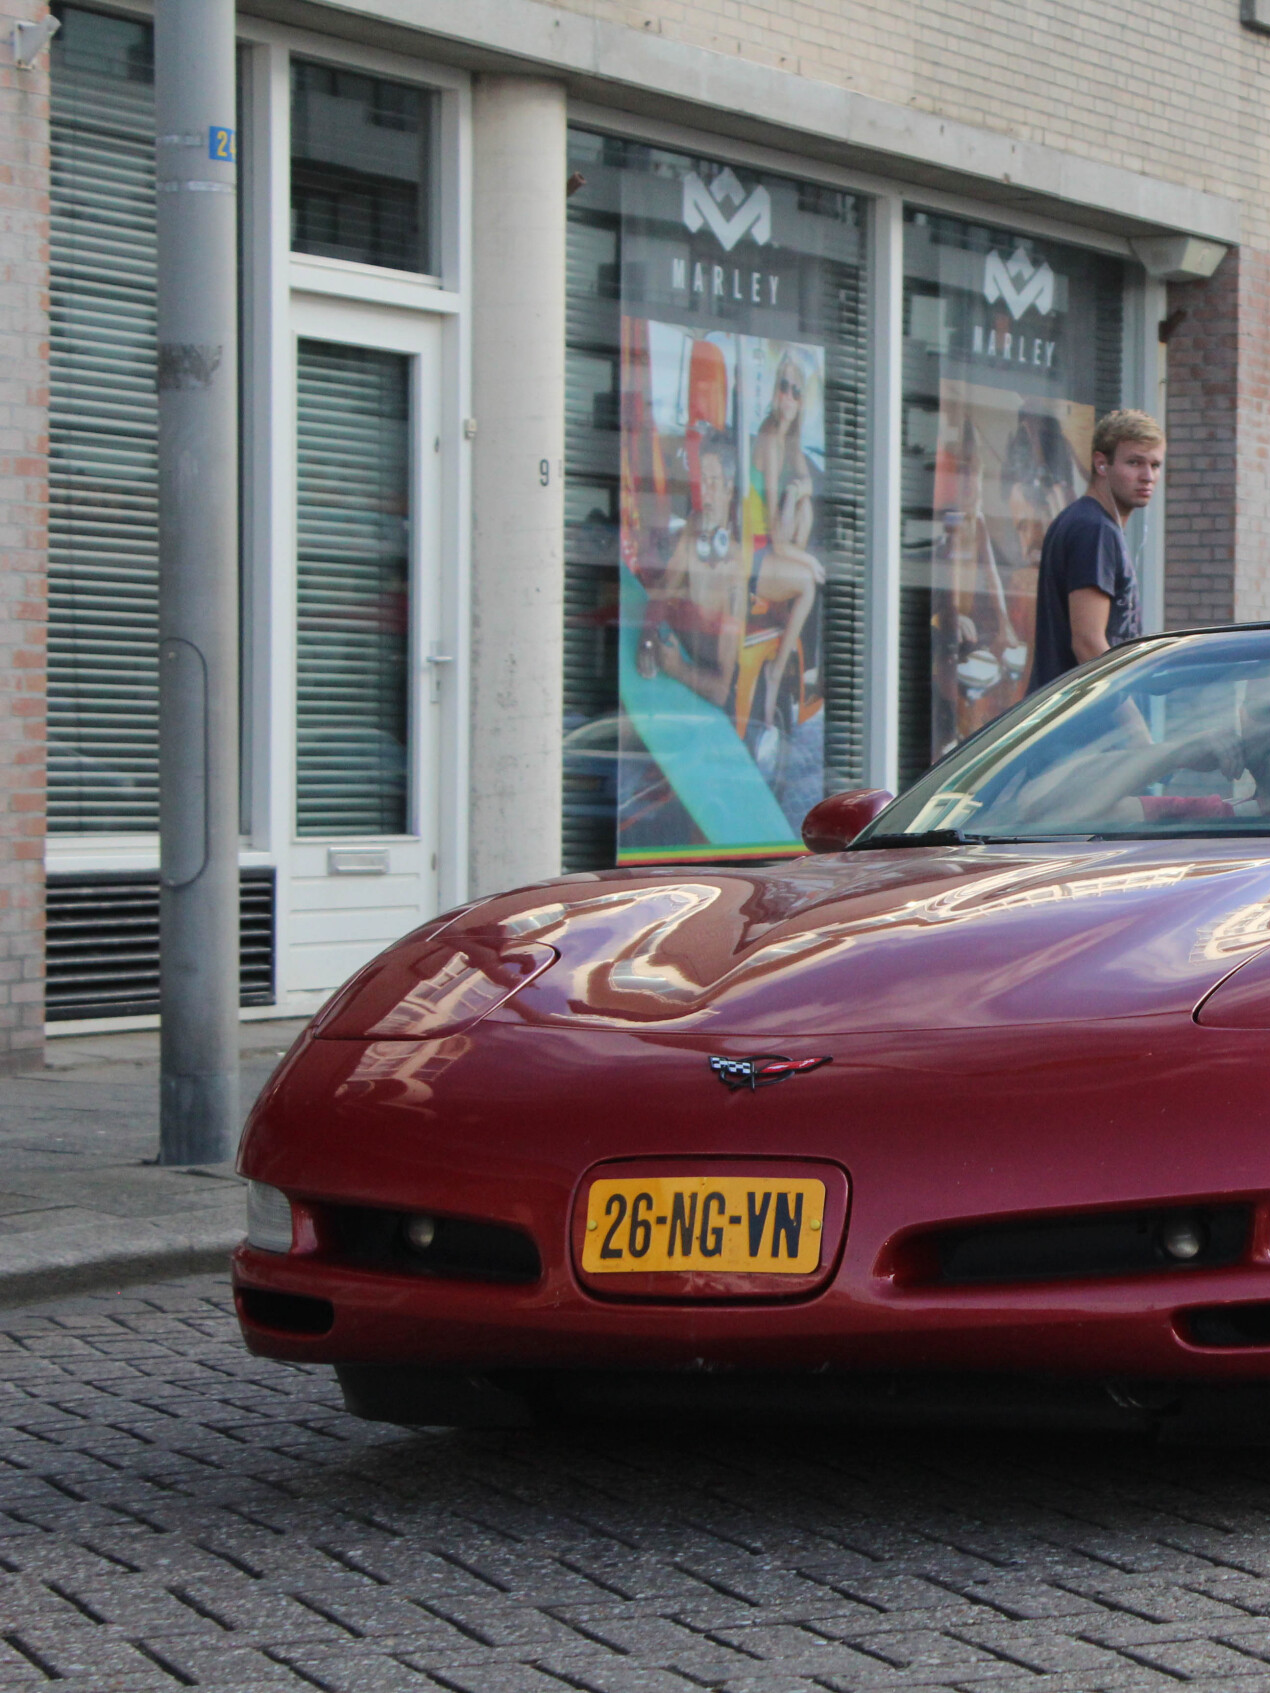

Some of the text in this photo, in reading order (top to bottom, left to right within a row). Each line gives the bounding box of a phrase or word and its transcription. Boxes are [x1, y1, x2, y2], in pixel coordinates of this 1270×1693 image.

[672, 258, 779, 305] MARLEY
[973, 325, 1055, 368] MARLEY
[540, 459, 550, 487] 9
[599, 1191, 804, 1260] 26-NG-VN
